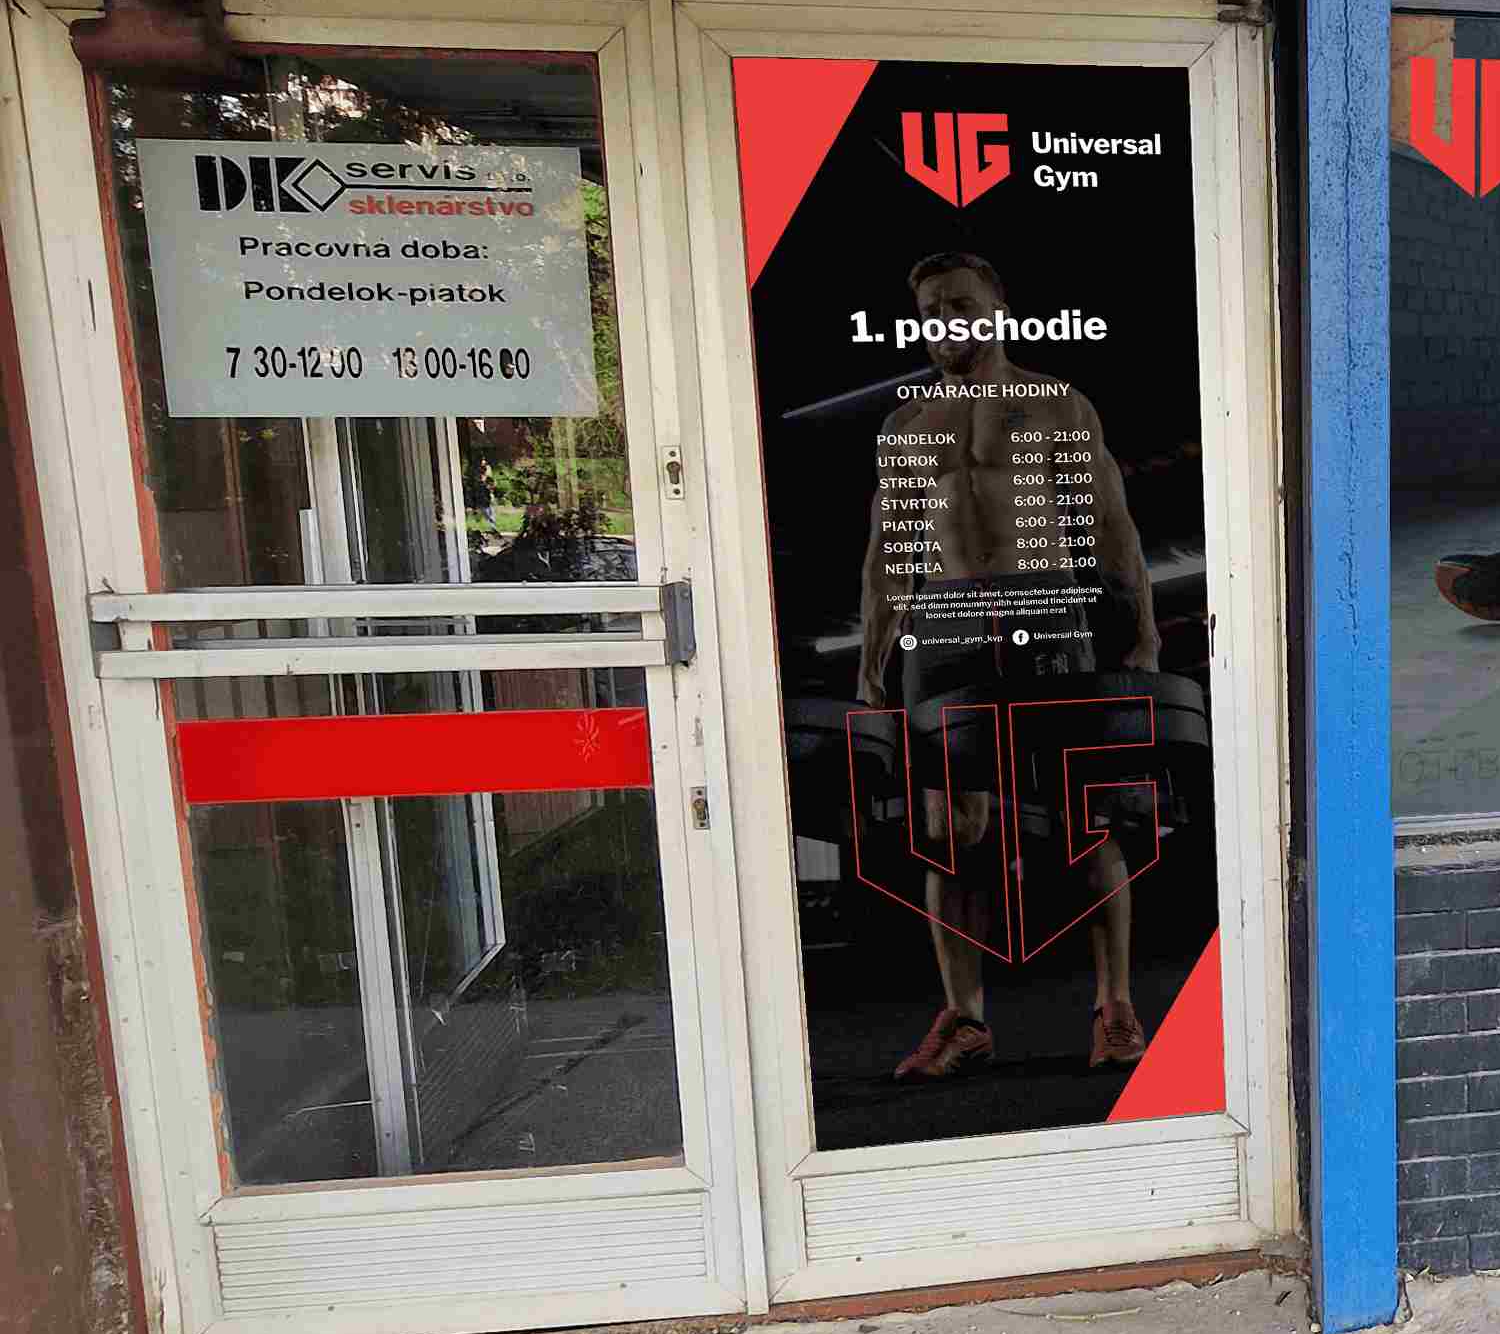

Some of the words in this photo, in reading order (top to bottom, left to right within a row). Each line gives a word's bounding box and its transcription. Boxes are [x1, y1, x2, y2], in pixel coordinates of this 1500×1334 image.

[1032, 131, 1161, 156] Universal
[345, 160, 477, 181] servis
[1033, 164, 1099, 192] Gym
[401, 238, 489, 260] doba:
[243, 280, 506, 306] Pondelok-piatok
[850, 310, 884, 343] 1.
[895, 309, 1108, 348] poschodie
[897, 382, 1000, 400] OTVÁRACIE
[1002, 383, 1070, 397] HODINY
[877, 433, 956, 446] PONDELOK
[1010, 431, 1042, 443] 6:00
[1053, 430, 1090, 442] 21:00
[878, 455, 938, 467] UTOROK
[1012, 452, 1043, 464] 6:00
[1054, 451, 1091, 463] 21:00
[879, 476, 937, 489] STREDA
[1013, 474, 1045, 485] 6:00
[1055, 473, 1093, 484] 21:00
[881, 497, 949, 511] ŠTVRTOK
[1014, 495, 1046, 506] 6:00
[1056, 494, 1093, 505] 21:00
[882, 519, 936, 531] PIATOK
[1015, 516, 1047, 528] 6:00
[1057, 515, 1094, 526] 21:00
[883, 541, 942, 554] SOBOTA
[1016, 537, 1048, 549] 8:00
[1058, 536, 1095, 547] 21:00
[1017, 558, 1049, 570] 8:00
[1059, 557, 1097, 568] 21:00
[886, 594, 914, 602] Lorem
[915, 593, 942, 602] ipsum
[943, 591, 965, 600] dolor
[966, 590, 978, 598] sit
[911, 602, 927, 610] sed
[1033, 630, 1072, 640] Universal
[1073, 630, 1093, 640] Gym
